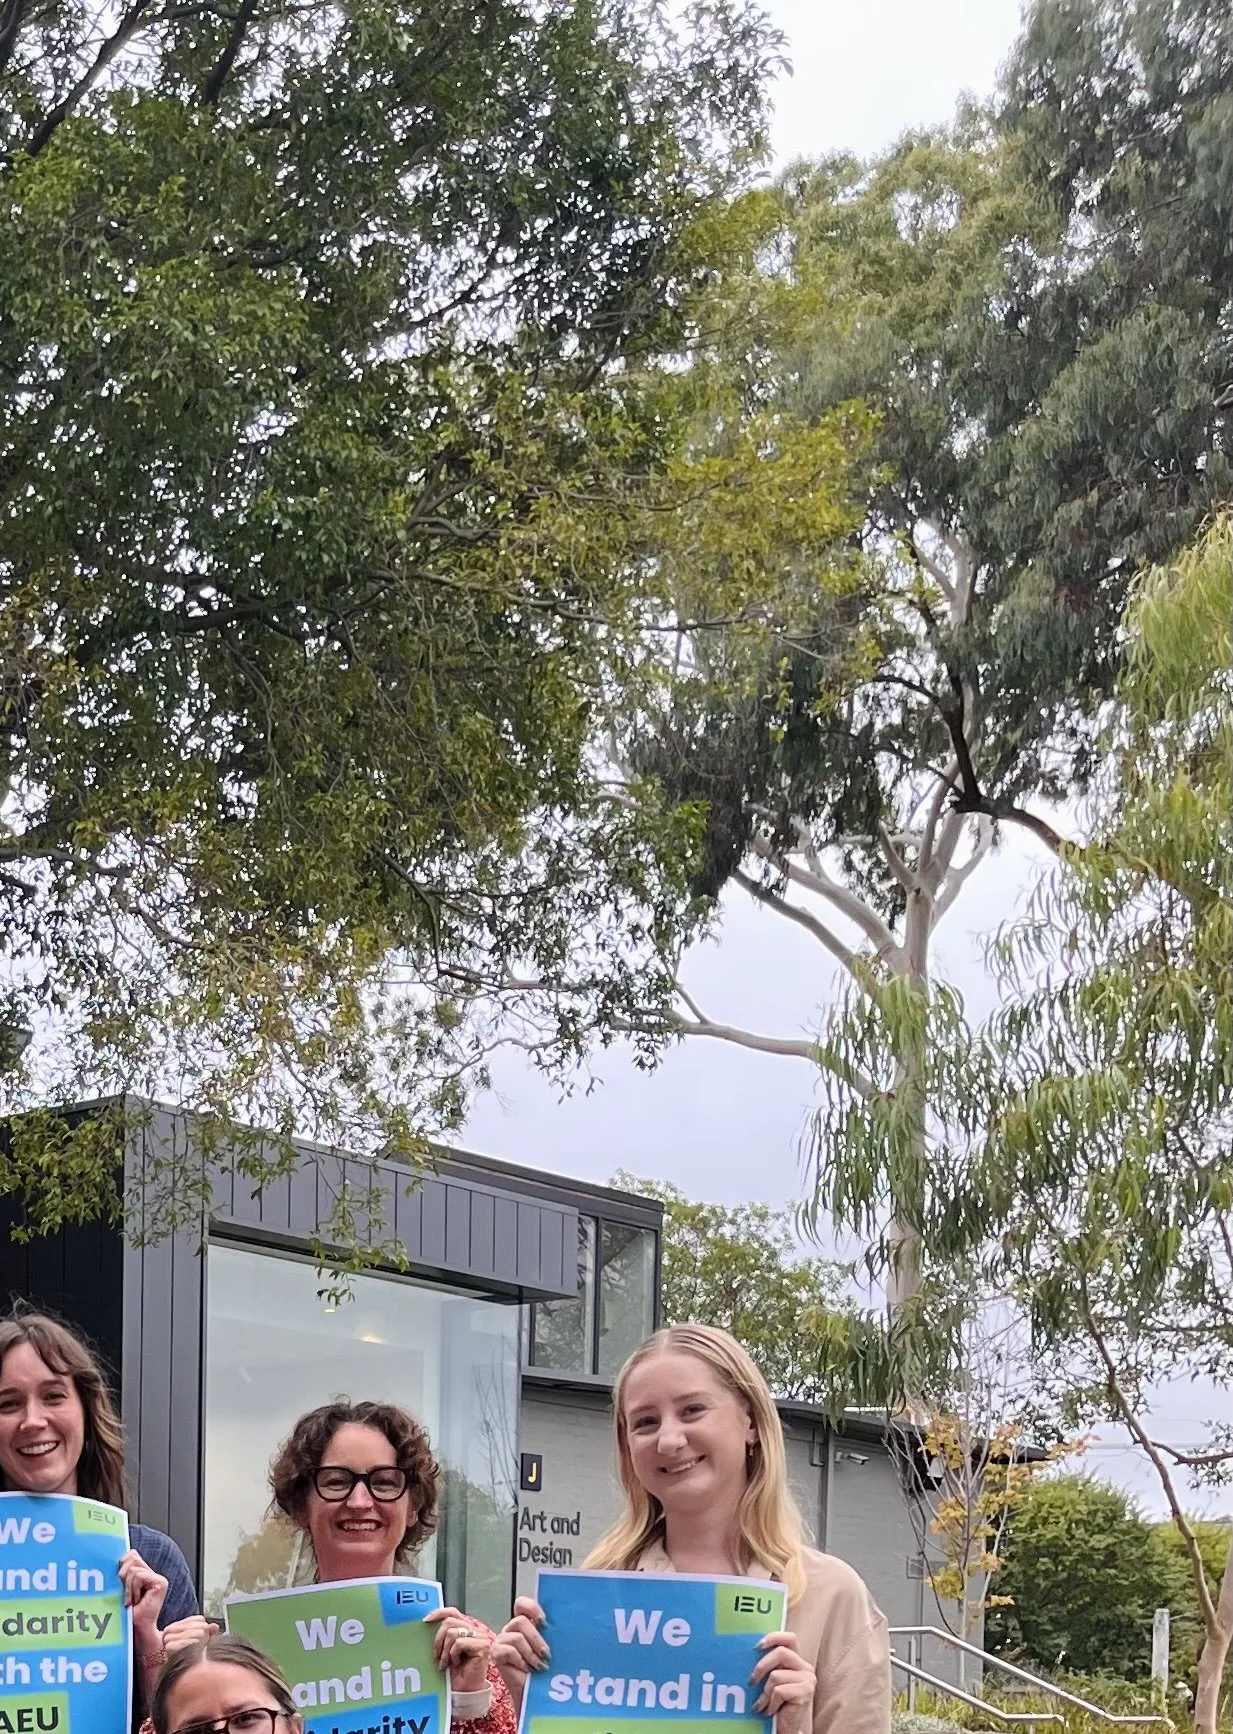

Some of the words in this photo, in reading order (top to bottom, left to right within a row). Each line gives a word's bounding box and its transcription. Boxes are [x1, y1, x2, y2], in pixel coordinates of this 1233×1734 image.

[528, 1462, 537, 1484] J
[87, 1509, 116, 1525] IEU
[519, 1506, 548, 1534] Art
[550, 1511, 581, 1536] and
[519, 1537, 573, 1568] Design
[68, 1561, 103, 1590] in
[396, 1590, 429, 1605] IEU
[735, 1596, 771, 1613] IEU
[295, 1615, 364, 1651] We
[615, 1610, 690, 1646] We
[41, 1657, 107, 1682] the
[291, 1666, 372, 1708] and
[380, 1660, 421, 1696] in
[549, 1669, 690, 1709] stand
[702, 1672, 745, 1713] in
